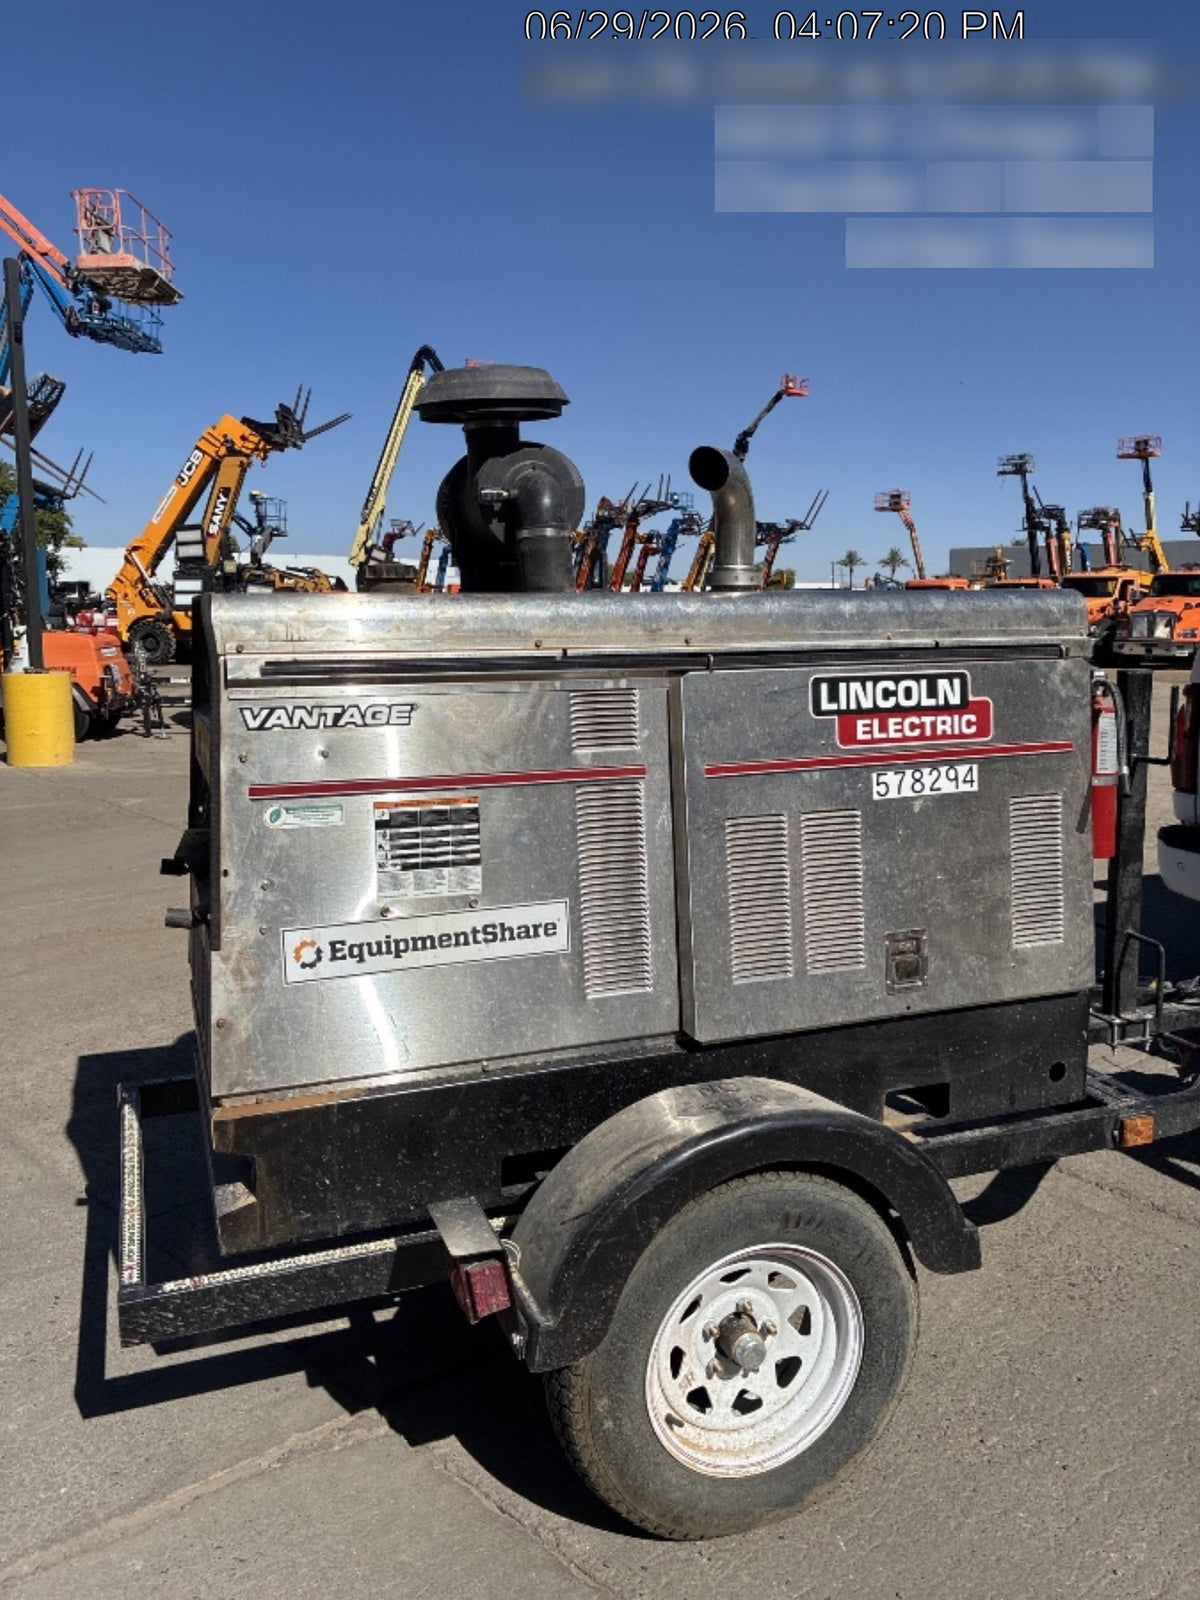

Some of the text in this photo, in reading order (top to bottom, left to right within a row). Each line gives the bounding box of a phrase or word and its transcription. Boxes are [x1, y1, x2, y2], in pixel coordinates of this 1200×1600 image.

[179, 449, 203, 487] JCB
[209, 494, 228, 535] SANY
[820, 678, 961, 711] LINCOLN
[240, 703, 414, 731] VANTAGE
[856, 714, 977, 740] ELECTRIC
[875, 765, 976, 797] 578294
[328, 921, 557, 963] EquipmentShare
